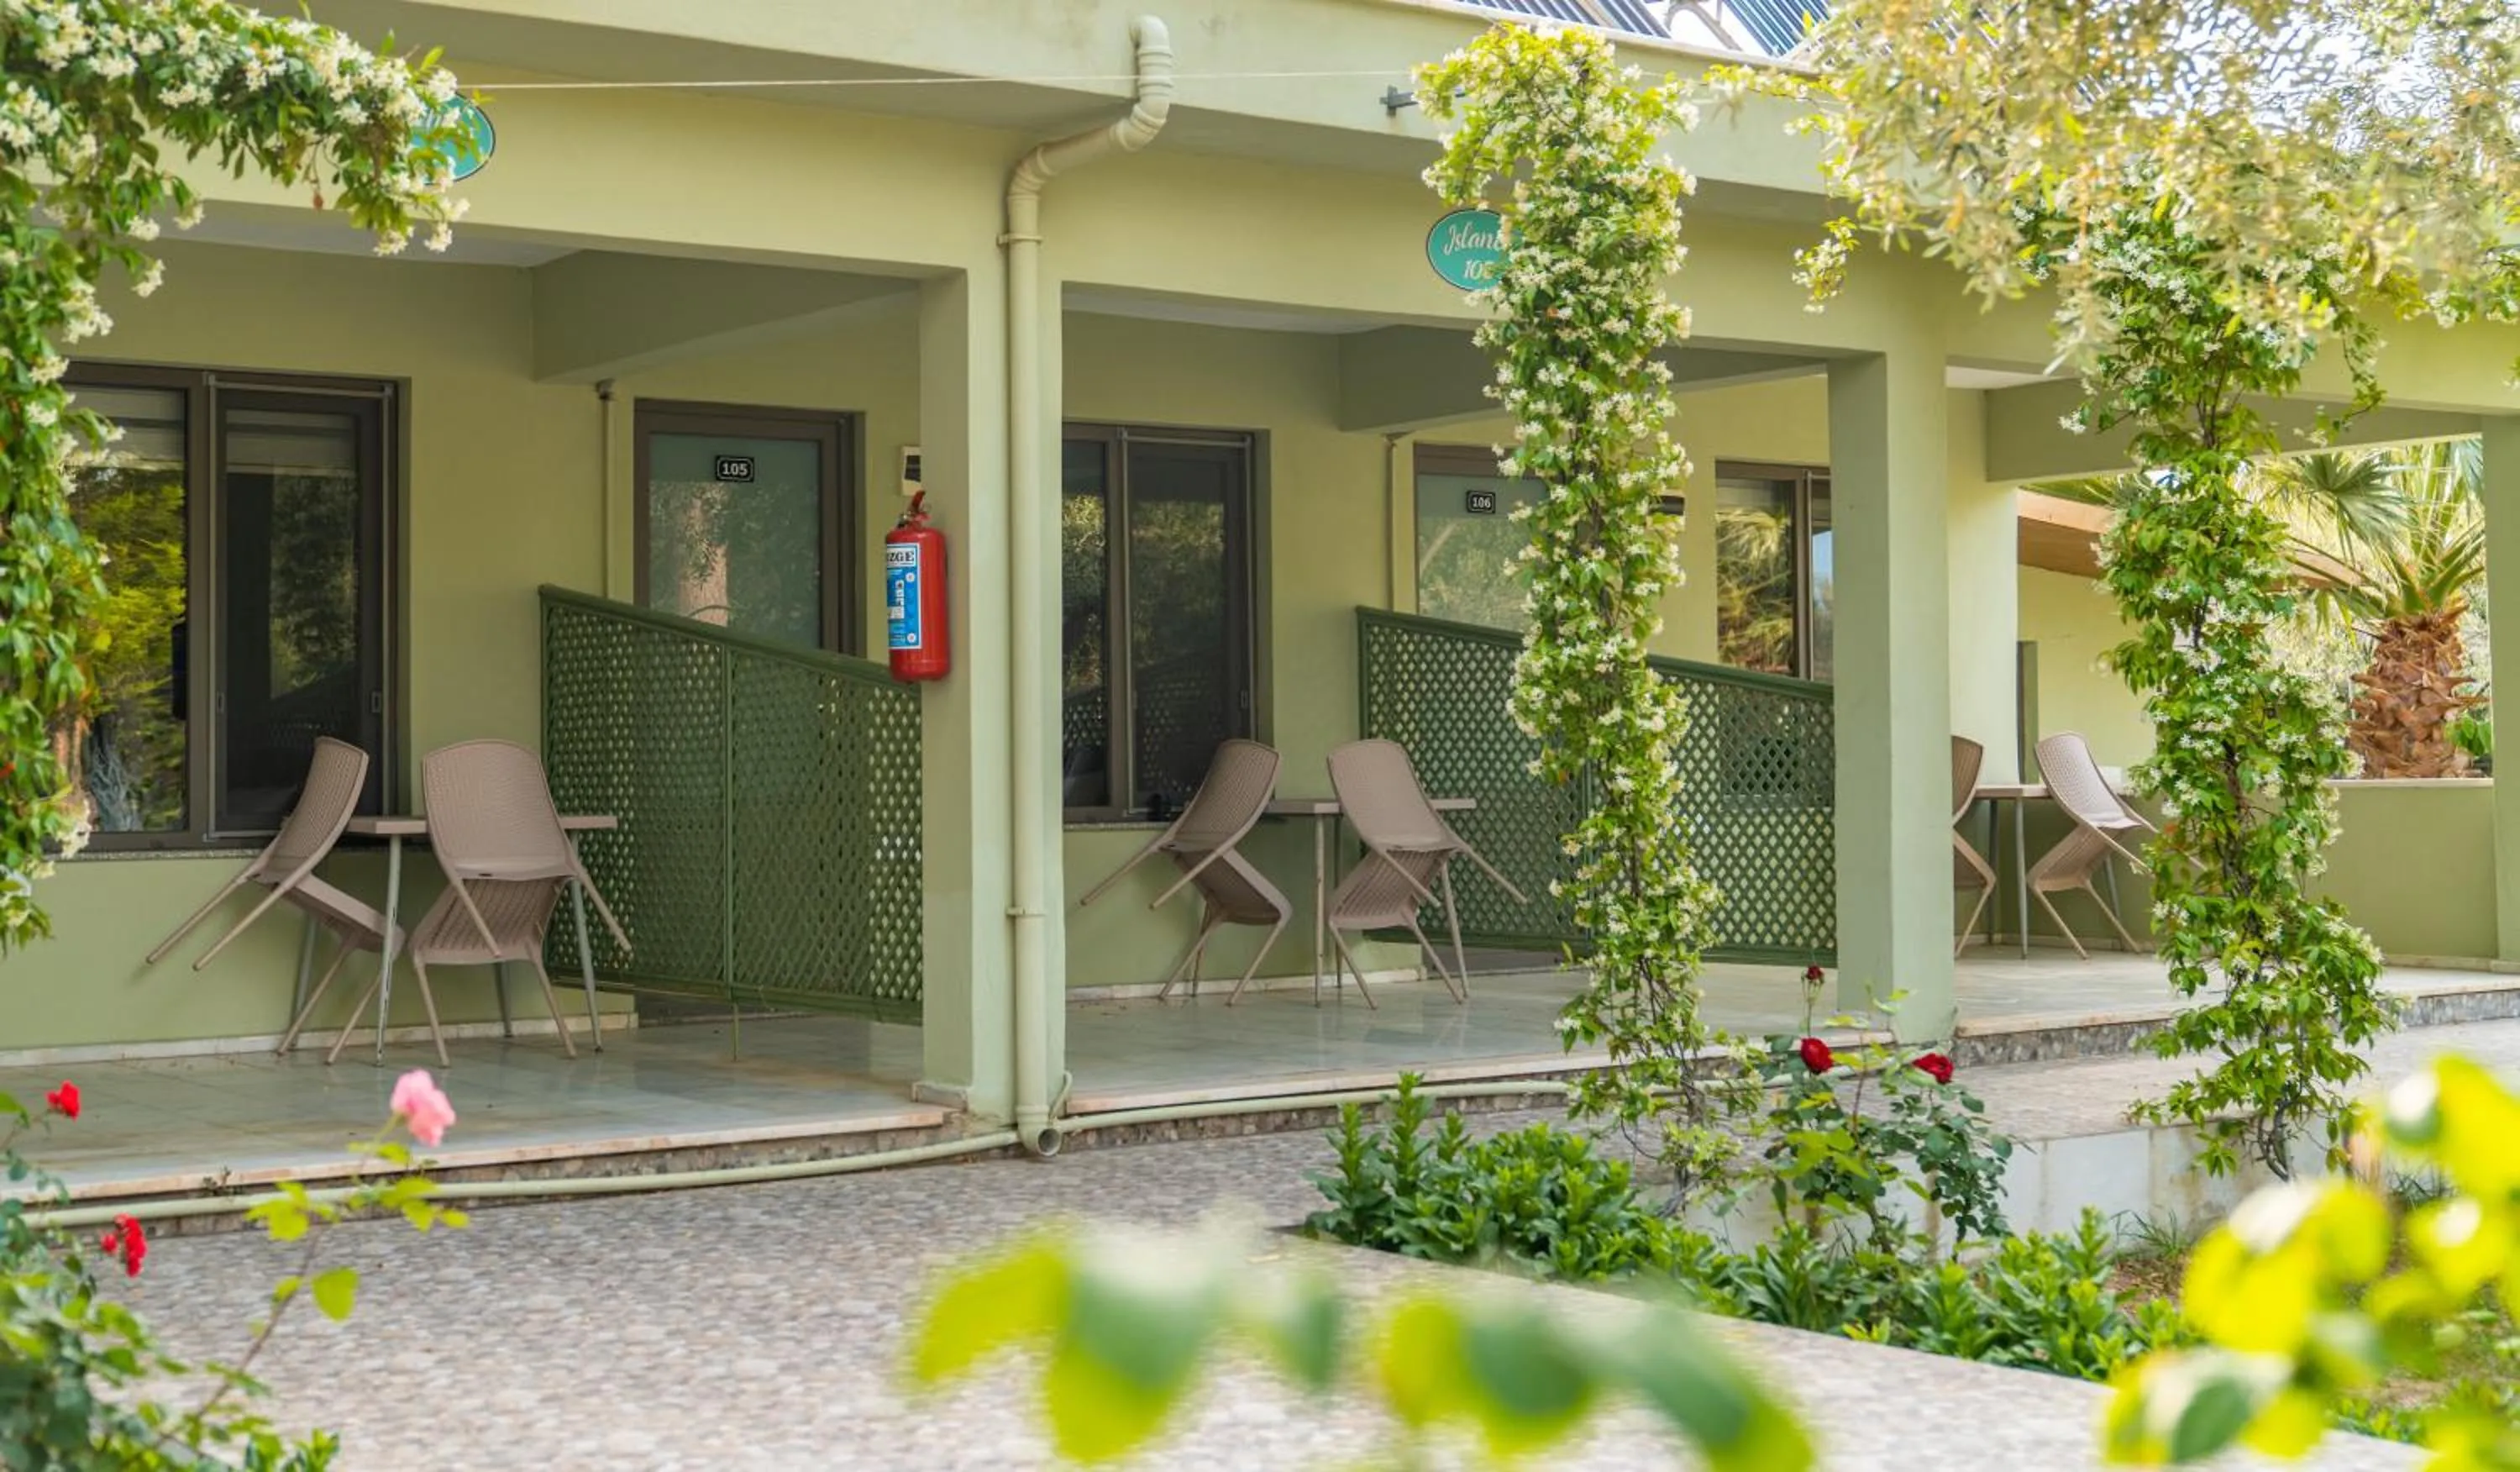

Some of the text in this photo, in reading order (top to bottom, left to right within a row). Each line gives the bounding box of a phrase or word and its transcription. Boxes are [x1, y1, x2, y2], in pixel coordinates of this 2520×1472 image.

[722, 463, 748, 476] 105
[1473, 497, 1491, 508] 106
[887, 550, 915, 562] ZGE
